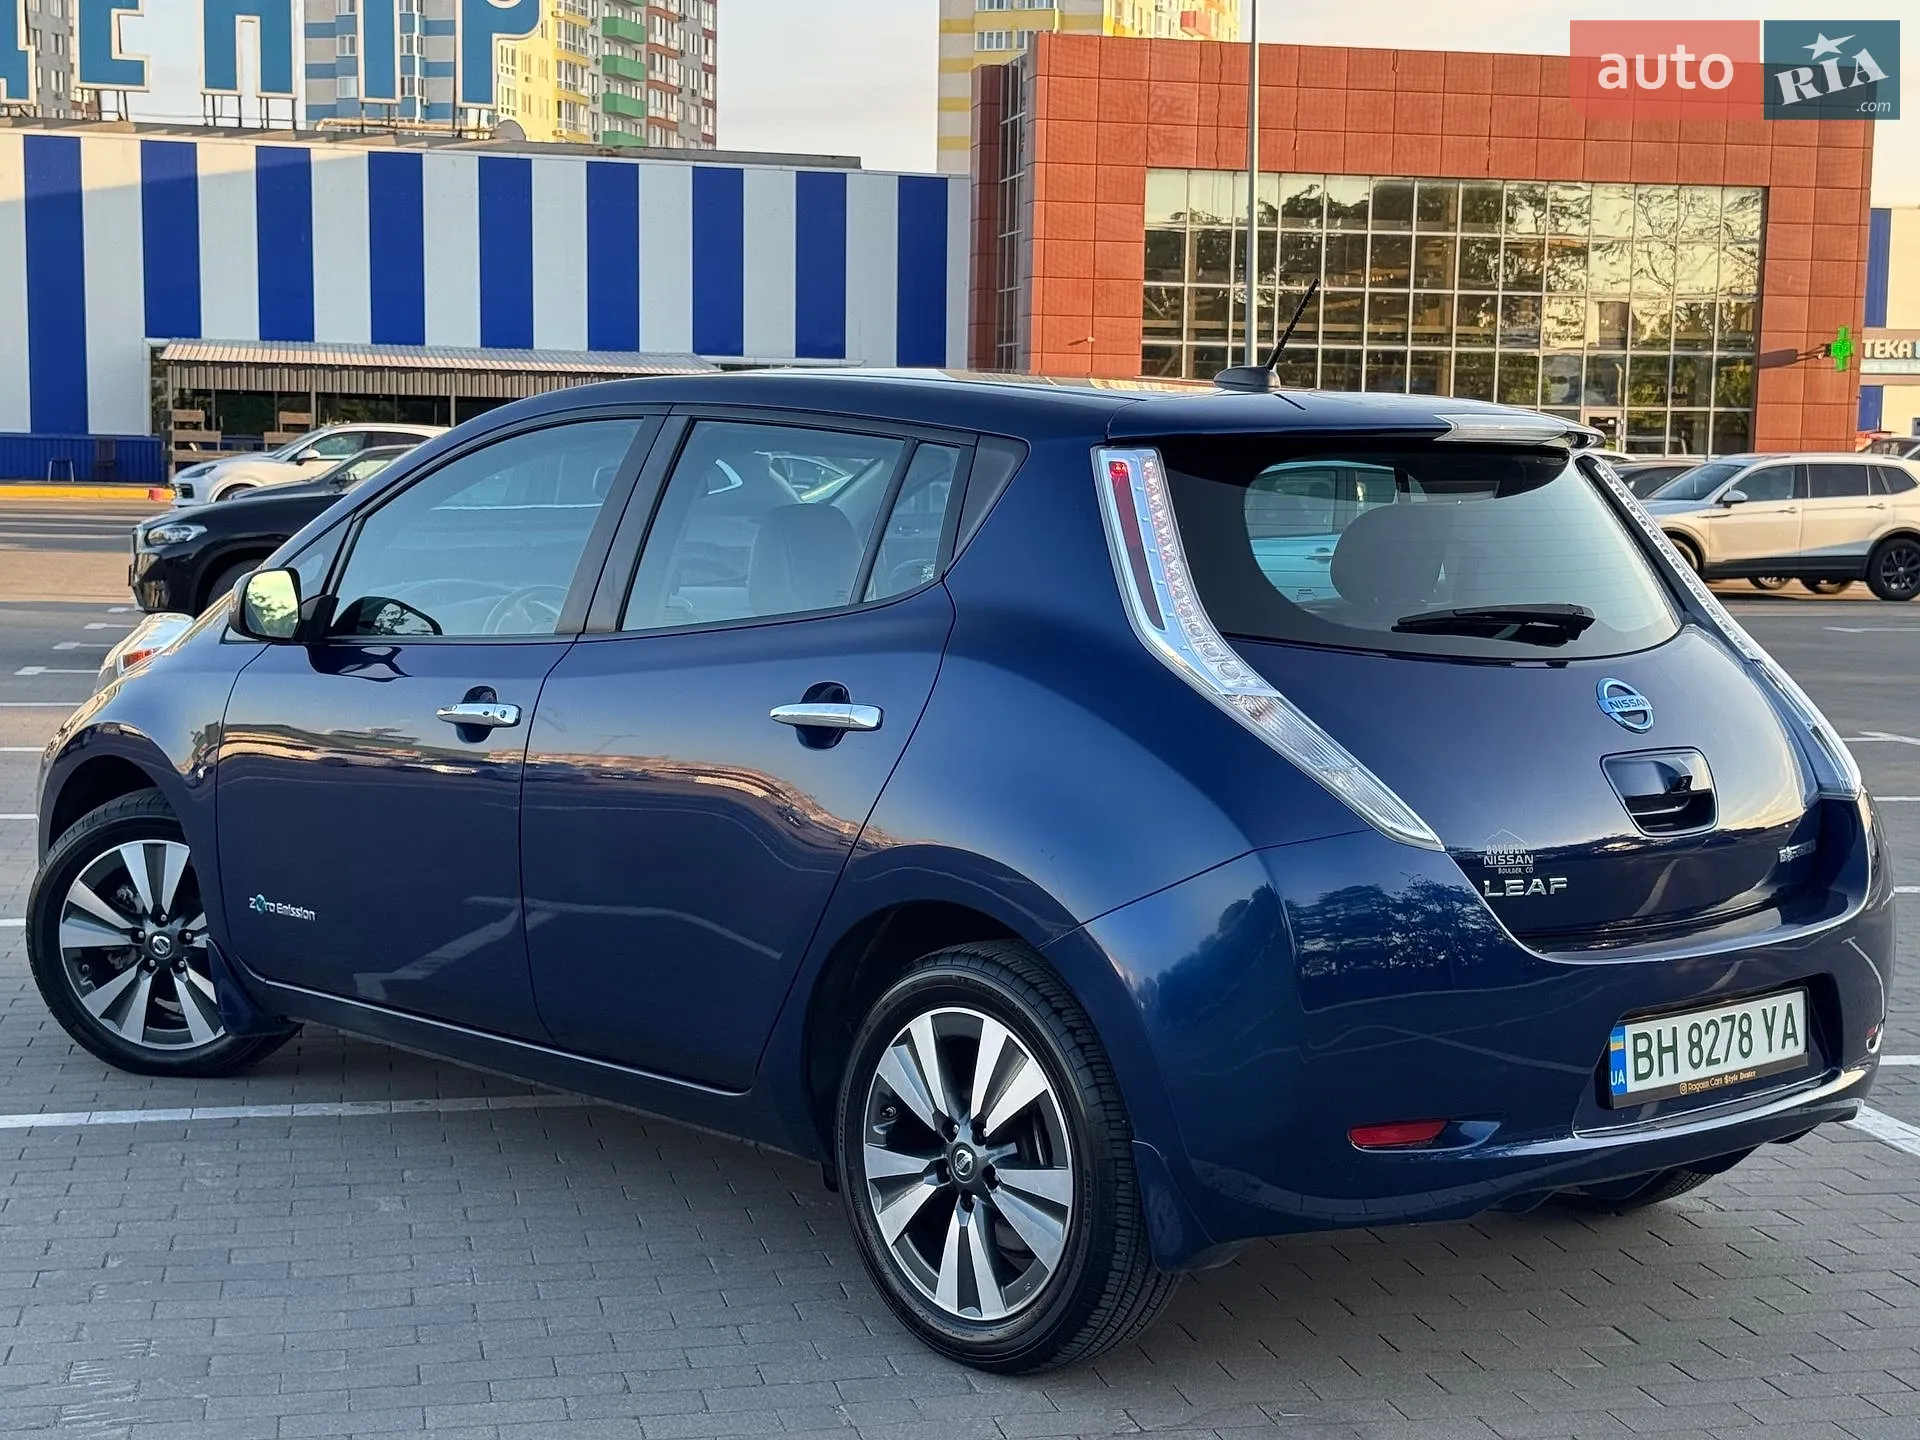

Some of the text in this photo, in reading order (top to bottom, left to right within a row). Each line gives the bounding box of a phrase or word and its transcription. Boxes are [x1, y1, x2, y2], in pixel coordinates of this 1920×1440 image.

[1607, 698, 1651, 710] NISSAN
[1483, 854, 1534, 866] NISSAN
[1483, 877, 1568, 898] LEAF
[1632, 1002, 1800, 1083] BH 8278 YA
[1610, 1068, 1626, 1087] UA
